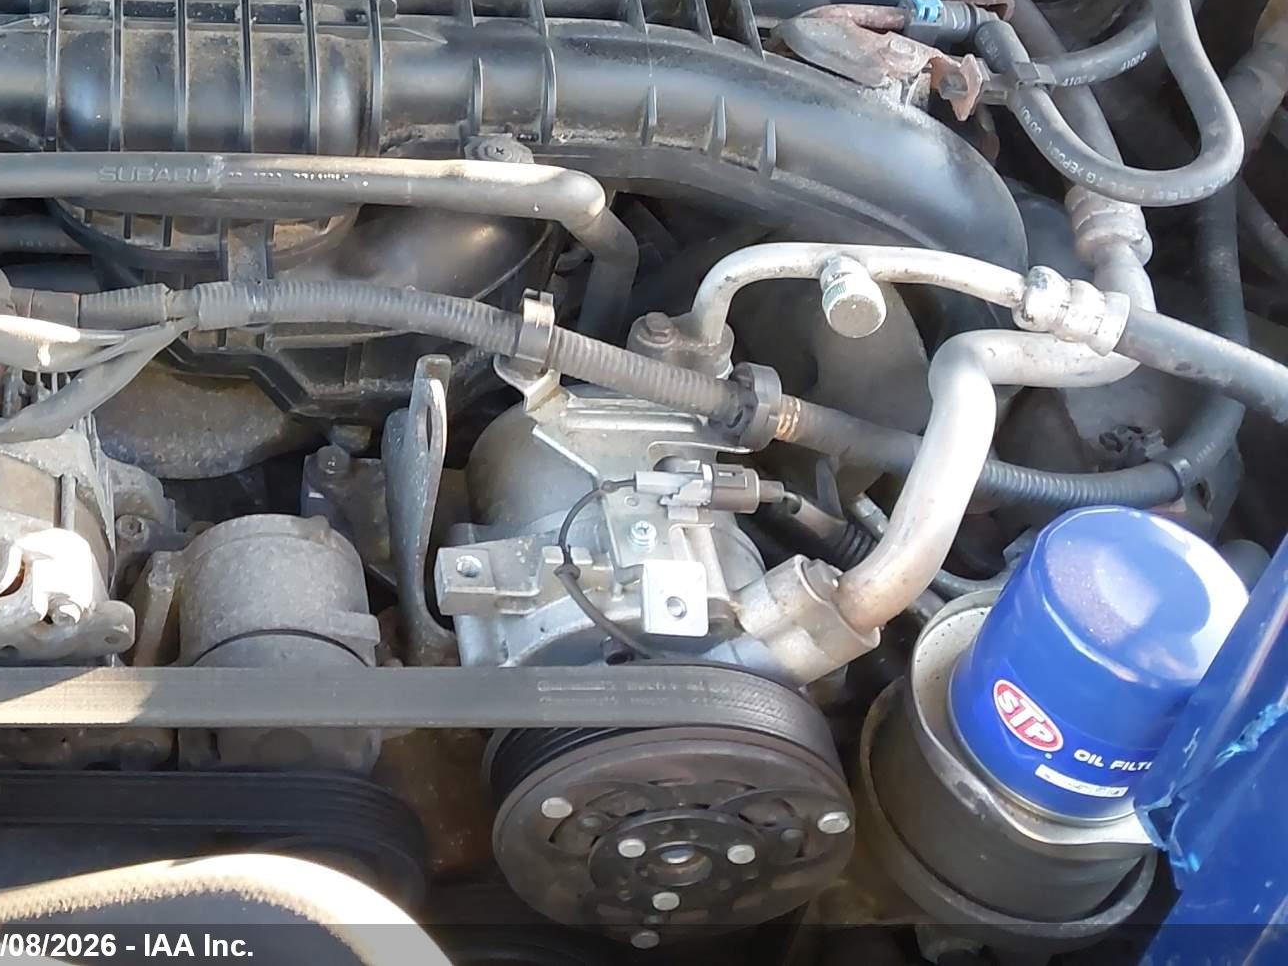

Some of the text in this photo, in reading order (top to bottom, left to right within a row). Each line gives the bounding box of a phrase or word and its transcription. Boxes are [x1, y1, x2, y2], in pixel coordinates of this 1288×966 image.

[98, 164, 213, 183] SUBARU
[997, 689, 1058, 743] STP
[1073, 748, 1153, 772] OIL FILT
